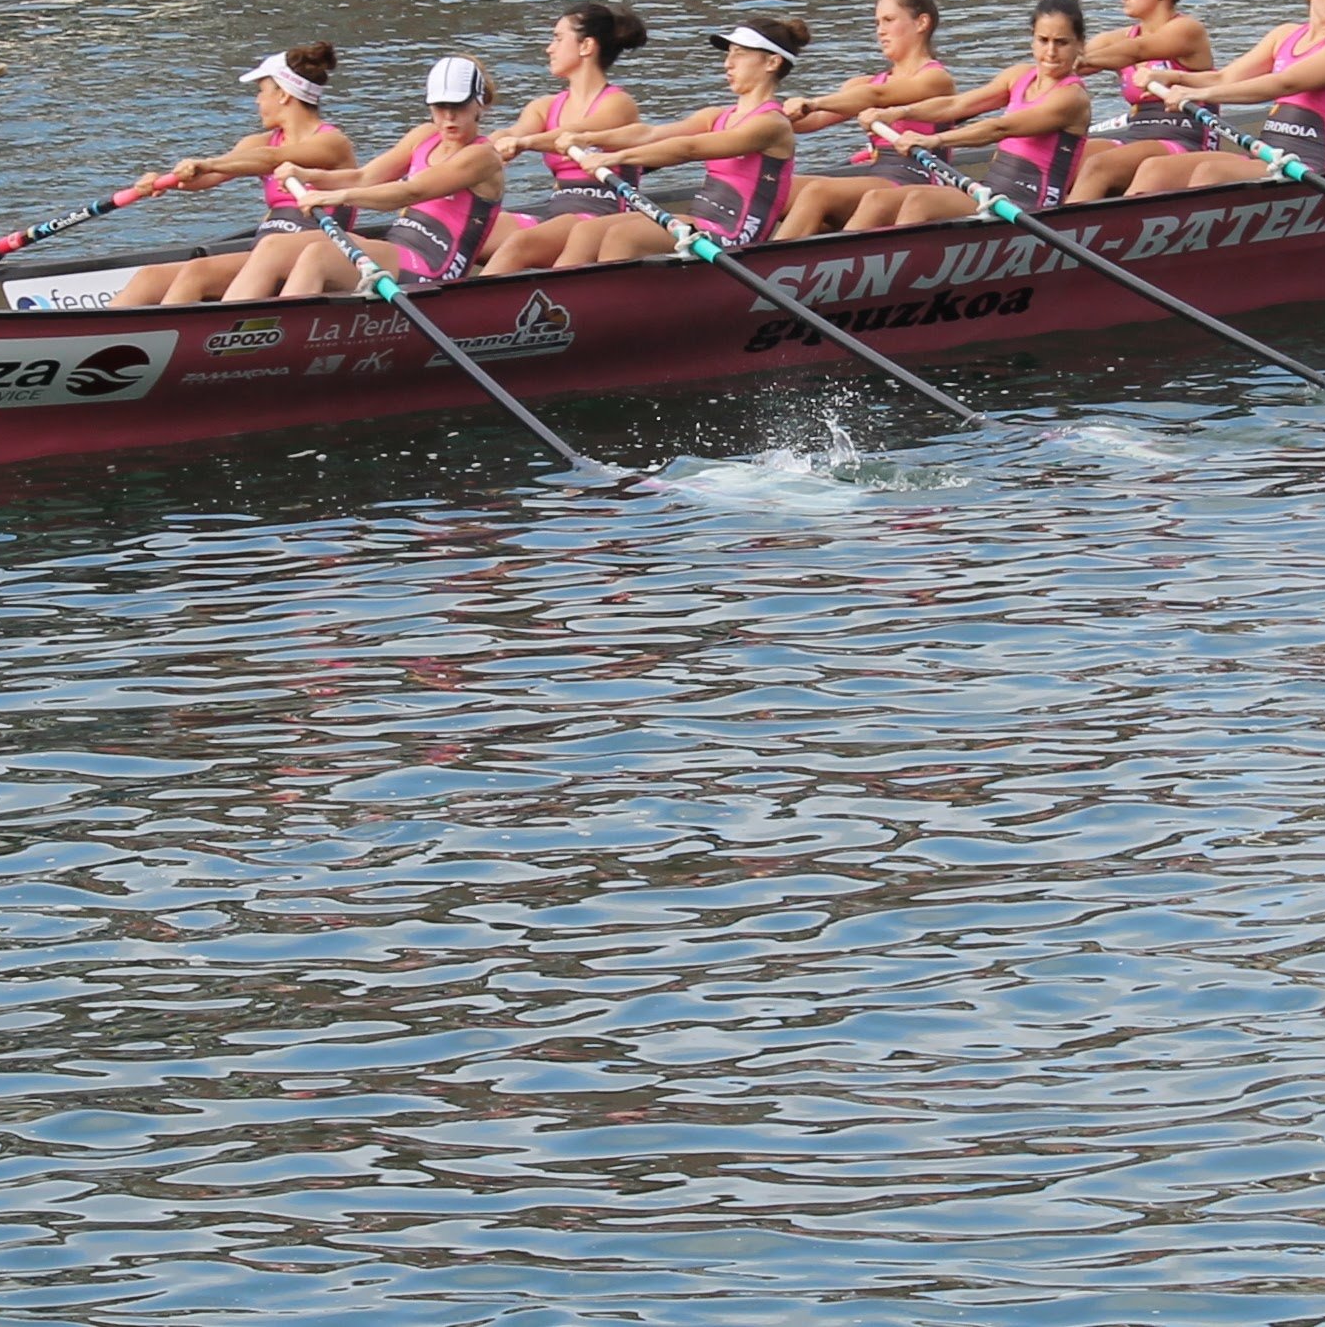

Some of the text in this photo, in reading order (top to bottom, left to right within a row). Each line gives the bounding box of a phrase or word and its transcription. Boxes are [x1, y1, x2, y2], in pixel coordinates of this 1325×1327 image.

[749, 250, 910, 313] SAN
[51, 289, 119, 310] fege
[307, 310, 410, 342] La Perla
